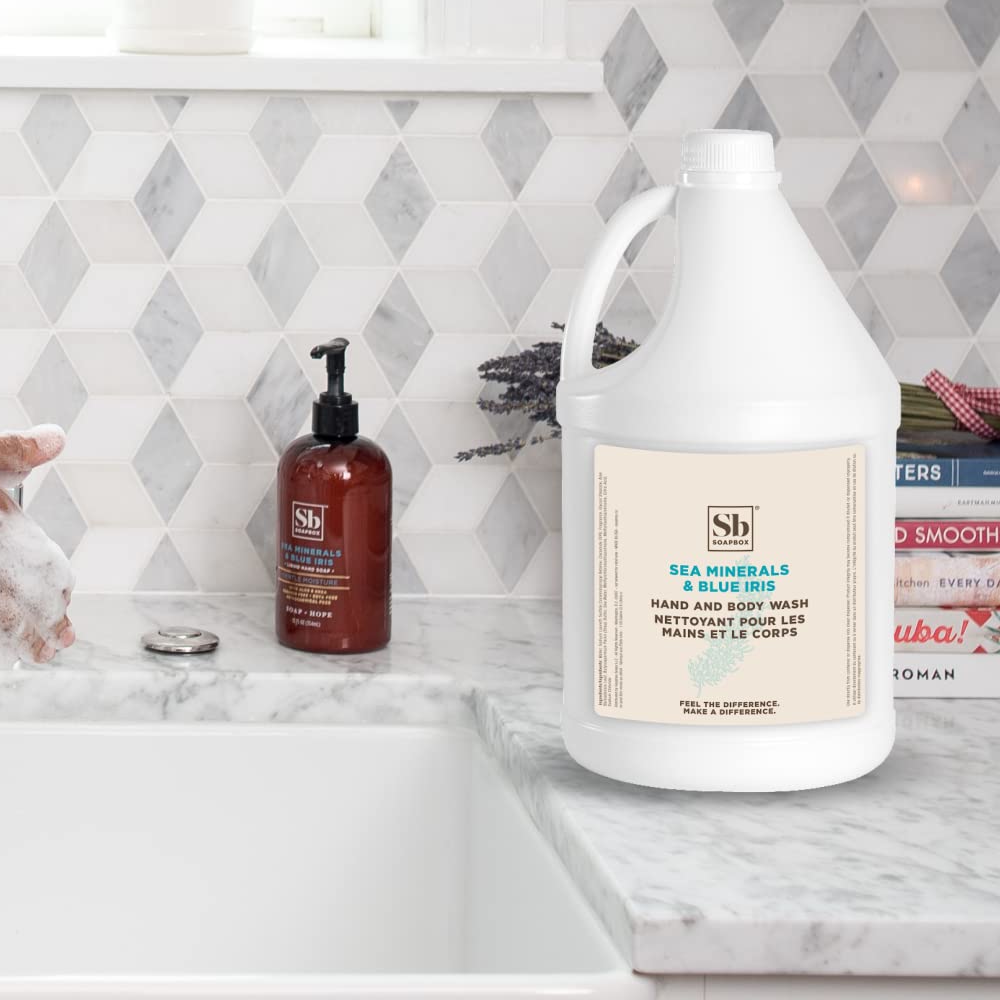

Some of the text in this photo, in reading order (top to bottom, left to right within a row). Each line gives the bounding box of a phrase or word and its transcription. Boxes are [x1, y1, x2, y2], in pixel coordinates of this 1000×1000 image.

[294, 507, 321, 530] Sb
[712, 513, 750, 537] Sb
[915, 526, 999, 544] SMOOTH
[294, 545, 342, 557] MINERALS
[290, 554, 311, 564] BLUE
[314, 557, 334, 566] IRIS
[669, 564, 790, 577] SEA MINERALS
[683, 580, 776, 593] & BLUE IRIS
[939, 578, 981, 588] EVERY
[651, 598, 809, 612] HAND AND BODY WASH
[309, 610, 333, 618] HOPE
[654, 614, 806, 627] NETTOYANT POUR LES
[662, 627, 798, 640] MAINS ET LE CORPS
[893, 667, 956, 681] ROMAN
[679, 700, 701, 708] FEEL
[723, 700, 780, 708] DIFFERENCE.
[719, 708, 776, 716] DIFFERENCE.
